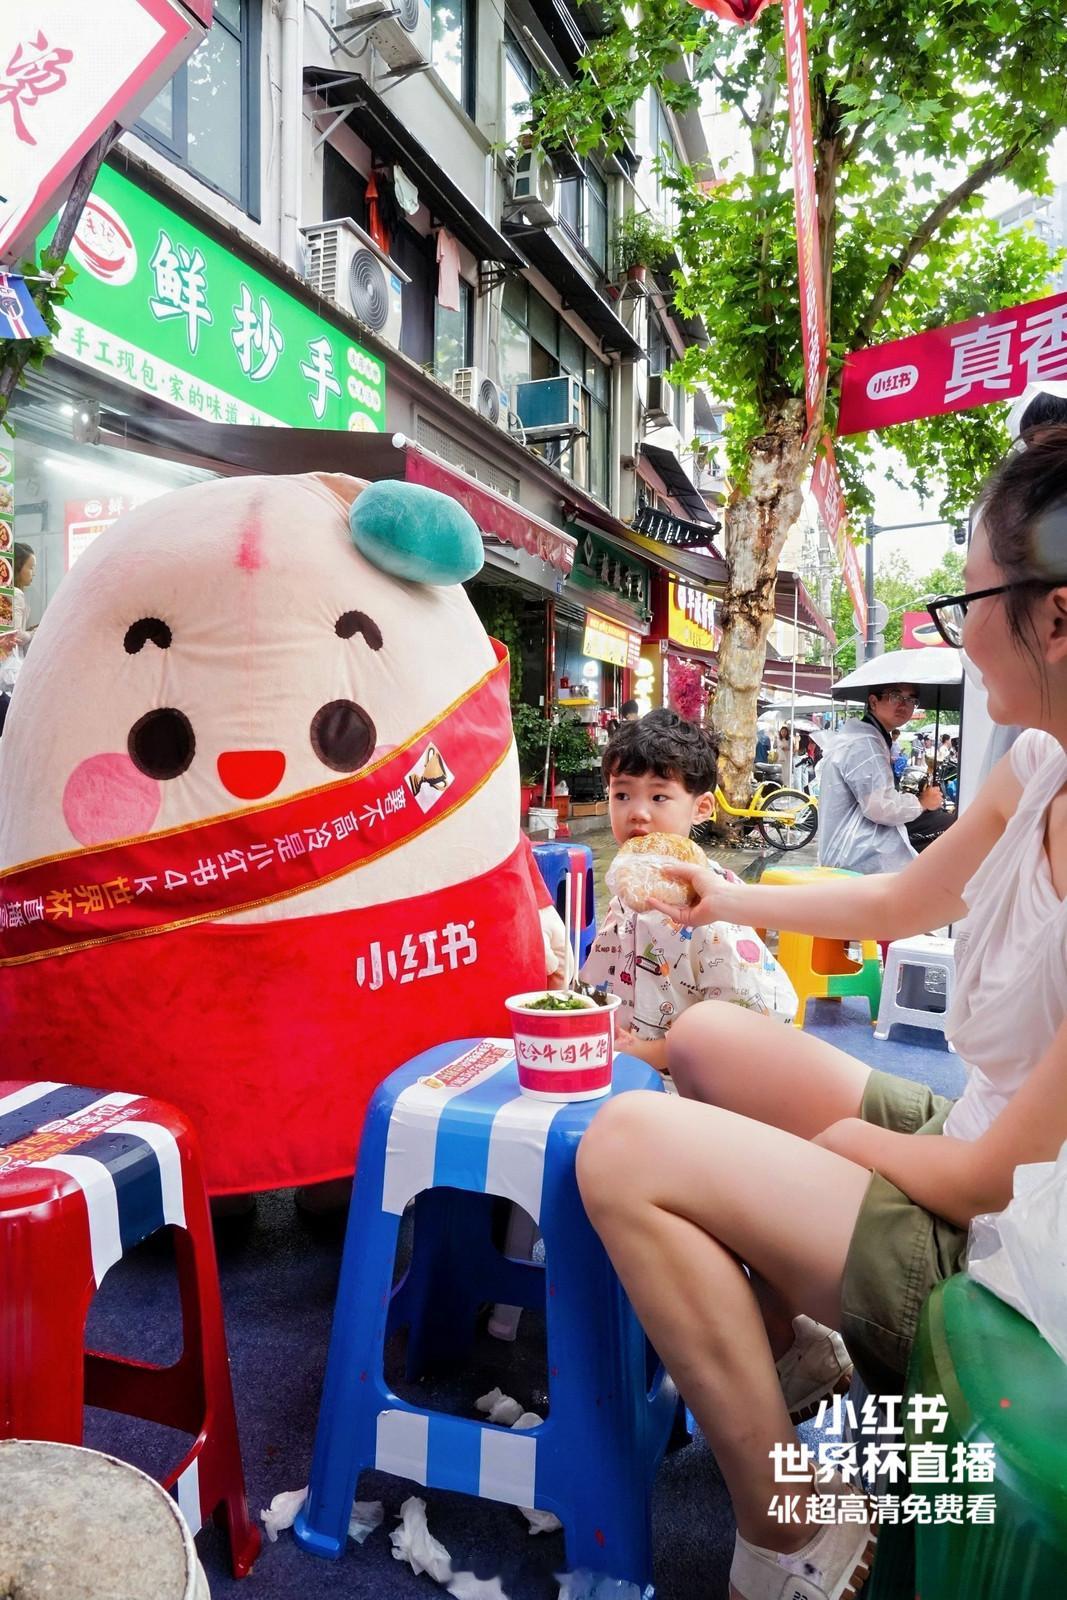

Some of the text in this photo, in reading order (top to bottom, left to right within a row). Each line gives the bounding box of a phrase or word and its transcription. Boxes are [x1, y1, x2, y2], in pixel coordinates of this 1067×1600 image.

[148, 231, 342, 420] 鲜抄手
[874, 372, 912, 393] 小红书
[355, 921, 480, 992] 小红书
